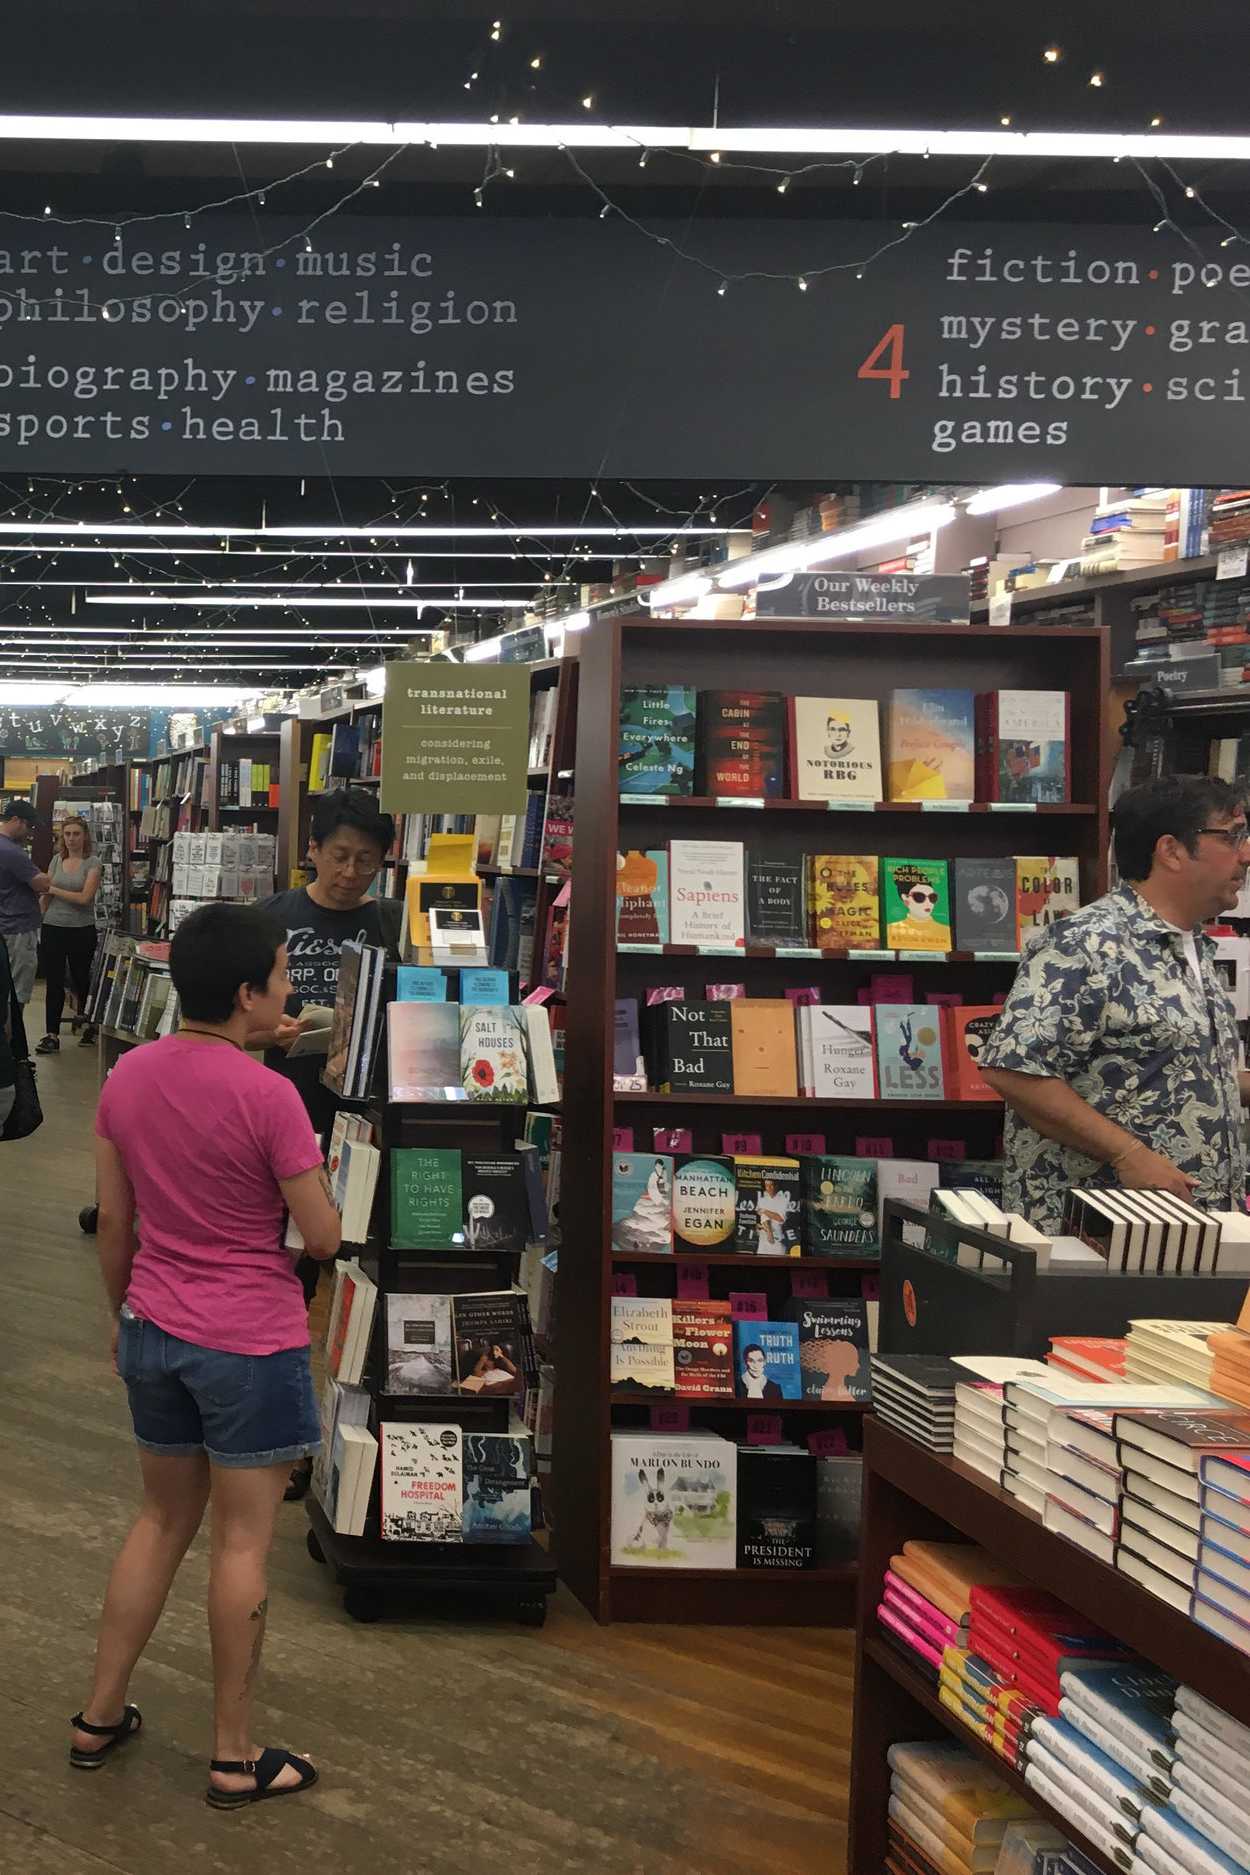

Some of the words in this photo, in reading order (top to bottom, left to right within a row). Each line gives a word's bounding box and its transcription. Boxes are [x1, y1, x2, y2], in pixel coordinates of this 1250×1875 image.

[102, 244, 266, 285] design
[295, 244, 434, 278] music
[946, 248, 1140, 284] fiction
[1172, 261, 1250, 294] poe
[295, 292, 518, 333] religion
[940, 314, 1136, 351] mystery
[1169, 318, 1250, 352] gra
[857, 324, 910, 399] 4
[265, 361, 516, 400] magazines
[937, 364, 1132, 409] history
[1166, 370, 1247, 400] sci
[181, 408, 346, 442] health
[931, 419, 1068, 452] games
[814, 578, 850, 593] Our
[856, 577, 919, 597] Weekly
[817, 597, 916, 614] Bestsellers
[1157, 670, 1189, 683] Poetry
[407, 688, 507, 699] transnational
[420, 704, 492, 716] literature
[643, 701, 669, 709] Little
[722, 708, 749, 718] CABIN
[643, 717, 669, 725] Fires
[421, 739, 490, 750] considering
[623, 733, 688, 744] Everywhere
[731, 741, 749, 750] END
[406, 755, 467, 766] migration,
[472, 755, 504, 766] exile,
[806, 759, 873, 770] NOTORIOUS
[626, 763, 665, 772] Celeste
[668, 763, 683, 775] Ng
[823, 769, 857, 780] RBG
[403, 771, 424, 781] and
[428, 772, 507, 783] displacement
[716, 773, 749, 782] WORLD
[752, 875, 771, 883] THE
[775, 876, 798, 884] FACT
[1022, 877, 1073, 894] COLOR
[677, 888, 739, 905] Sapiens
[684, 921, 718, 931] History
[671, 1007, 706, 1022] Not
[475, 1022, 496, 1033] SALT
[478, 1038, 514, 1048] HOUSES
[689, 1031, 729, 1048] That
[822, 1044, 864, 1057] Hunger
[673, 1058, 705, 1073] Bad
[824, 1063, 865, 1075] Roxane
[833, 1077, 856, 1089] Gay
[885, 1066, 942, 1089] LESS
[417, 1158, 438, 1167] THE
[411, 1171, 447, 1180] RIGHT
[675, 1174, 732, 1184] MANHATTAN
[821, 1167, 871, 1182] LINCOLN
[898, 1173, 918, 1183] Bad
[403, 1184, 419, 1194] TO
[424, 1184, 454, 1194] HAVE
[680, 1185, 729, 1198] BEACH
[408, 1197, 450, 1207] RIGHTS
[683, 1206, 725, 1216] JENNIFER
[684, 1217, 724, 1229] EGAN
[821, 1229, 873, 1243] SAUNDERS
[613, 1305, 668, 1319] Elizabeth
[672, 1315, 715, 1325] Killers
[803, 1311, 861, 1328] Swimming
[622, 1321, 658, 1332] Strout
[685, 1327, 731, 1338] Flower
[814, 1324, 853, 1338] Lessons
[673, 1339, 709, 1349] Moon
[759, 1334, 793, 1347] TRUTH
[628, 1355, 669, 1367] Possible
[766, 1352, 794, 1364] RUTH
[675, 1383, 701, 1391] David
[1158, 1414, 1239, 1442] CIRCE
[631, 1457, 679, 1468] MARLON
[681, 1459, 721, 1469] BUNDO
[412, 1481, 456, 1491] FREEDOM
[401, 1490, 444, 1500] HOSPITAL
[744, 1546, 812, 1558] PRESIDENT
[763, 1559, 802, 1567] MISSING
